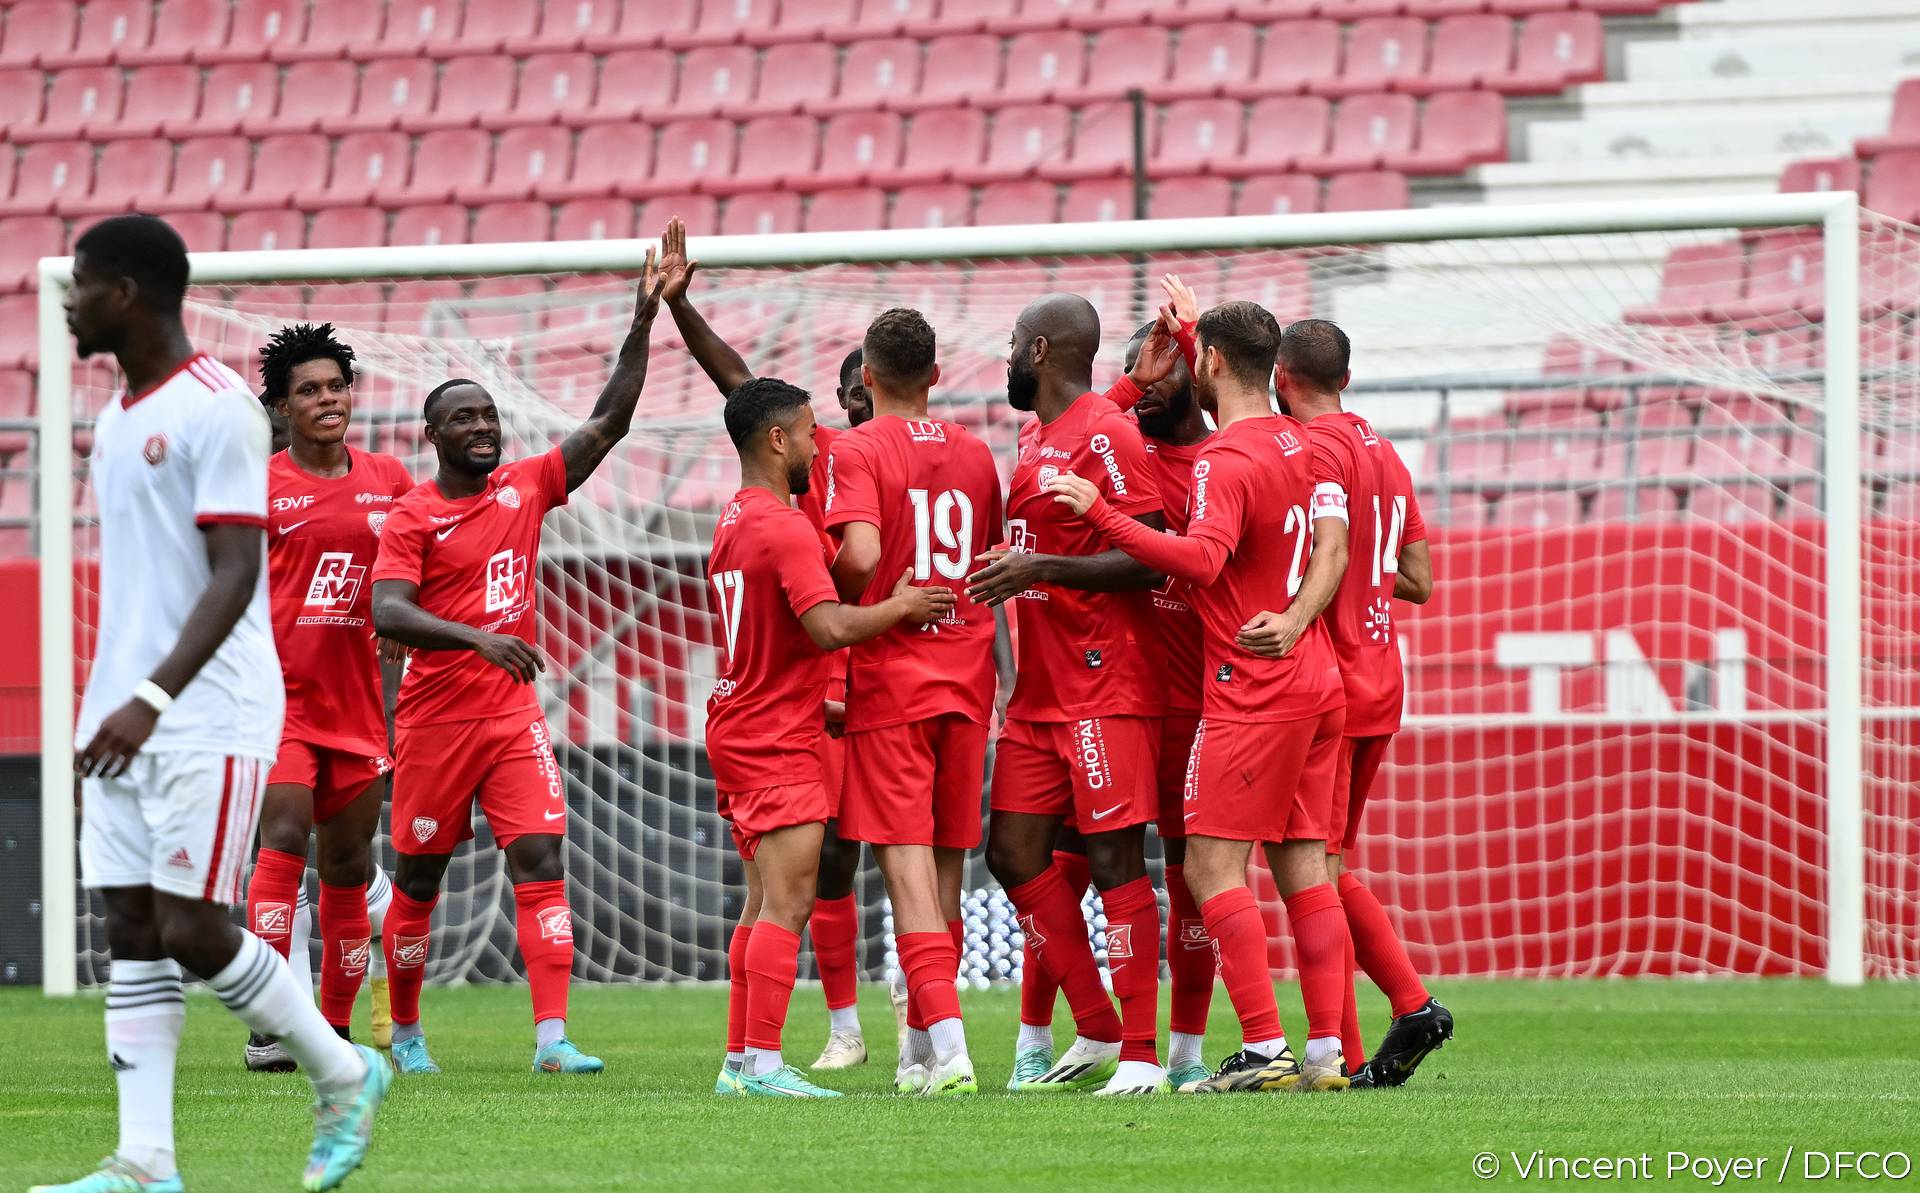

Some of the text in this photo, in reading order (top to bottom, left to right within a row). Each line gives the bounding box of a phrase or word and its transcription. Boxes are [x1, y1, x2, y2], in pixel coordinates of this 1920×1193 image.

[907, 420, 945, 438] LDS
[1102, 449, 1128, 496] leader
[1196, 478, 1209, 520] leader
[908, 488, 974, 580] 19
[1371, 493, 1407, 587] 14
[310, 580, 324, 599] BTP
[1153, 597, 1188, 612] ARTIN
[712, 569, 745, 664] 17
[530, 721, 560, 798] CHOPARD
[1073, 725, 1084, 768] GROUPE
